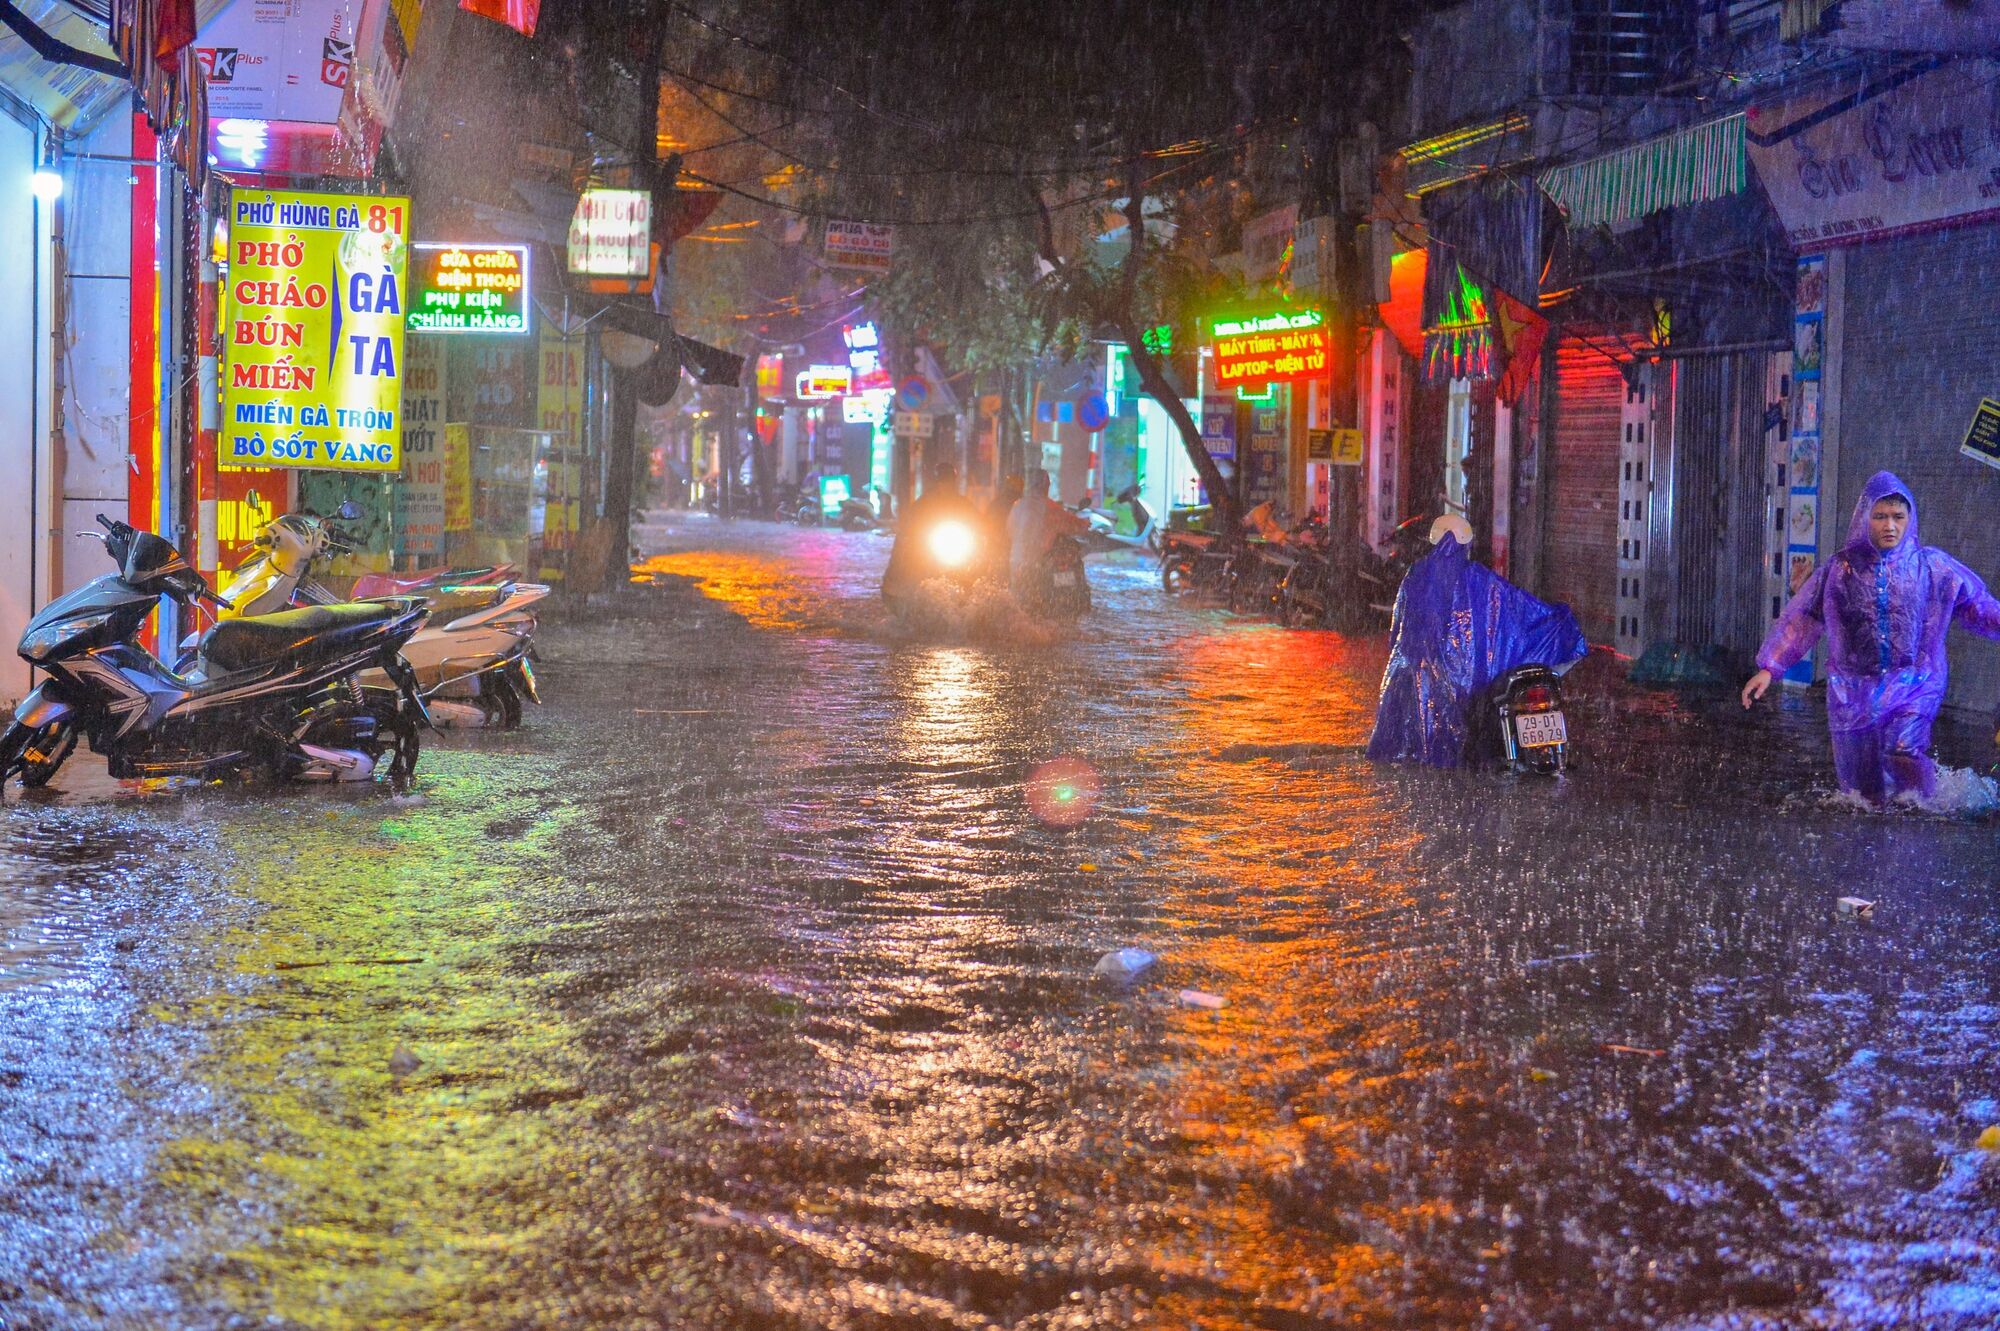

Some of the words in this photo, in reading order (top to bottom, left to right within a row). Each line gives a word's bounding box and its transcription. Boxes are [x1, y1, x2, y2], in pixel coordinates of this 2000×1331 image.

[329, 14, 342, 40] Plus
[237, 53, 263, 65] Plus
[237, 195, 275, 224] PHỞ
[280, 201, 330, 228] HÙNG
[336, 204, 360, 229] GÀ
[368, 204, 402, 235] 81
[237, 234, 304, 268] PHỞ
[235, 276, 327, 309] CHÁO
[349, 265, 401, 315] GÀ
[425, 292, 460, 309] PHỤ
[465, 288, 503, 309] KIỆN
[474, 273, 521, 292] THOẠI
[234, 314, 304, 347] BÚN
[408, 308, 465, 328] CHÍNH
[350, 335, 396, 377] TA
[1305, 348, 1326, 370] TỬ
[232, 355, 316, 391] MIẾN
[236, 400, 293, 425] MIẾN
[300, 403, 329, 426] GÀ
[336, 406, 393, 432] TRỘN
[233, 431, 265, 457] BÒ
[271, 431, 318, 459] SỐT
[323, 441, 393, 463] VANG
[1524, 714, 1556, 730] 29-D1
